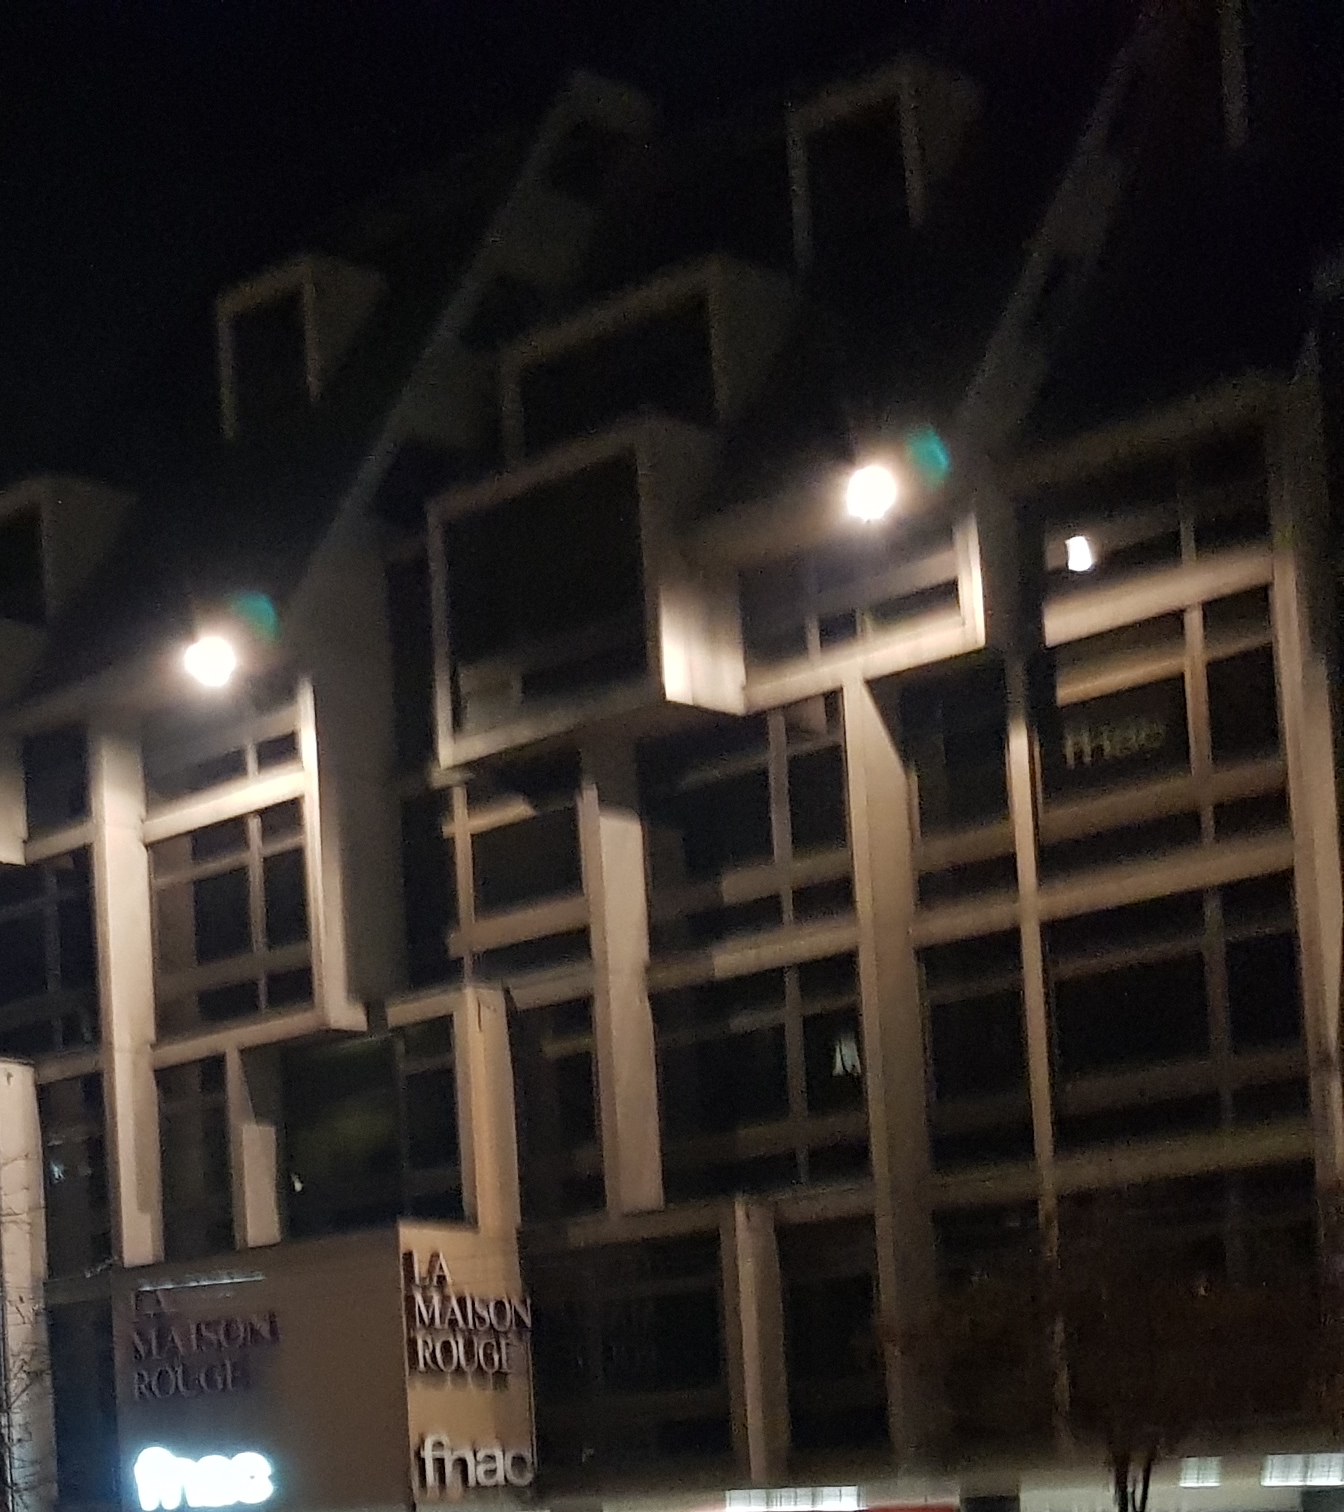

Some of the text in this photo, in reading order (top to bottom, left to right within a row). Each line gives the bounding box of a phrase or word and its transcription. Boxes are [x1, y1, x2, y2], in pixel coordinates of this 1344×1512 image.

[412, 1249, 453, 1287] LA
[413, 1290, 532, 1330] MAISON
[416, 1332, 513, 1373] ROUGE
[420, 1434, 534, 1488] fnac
